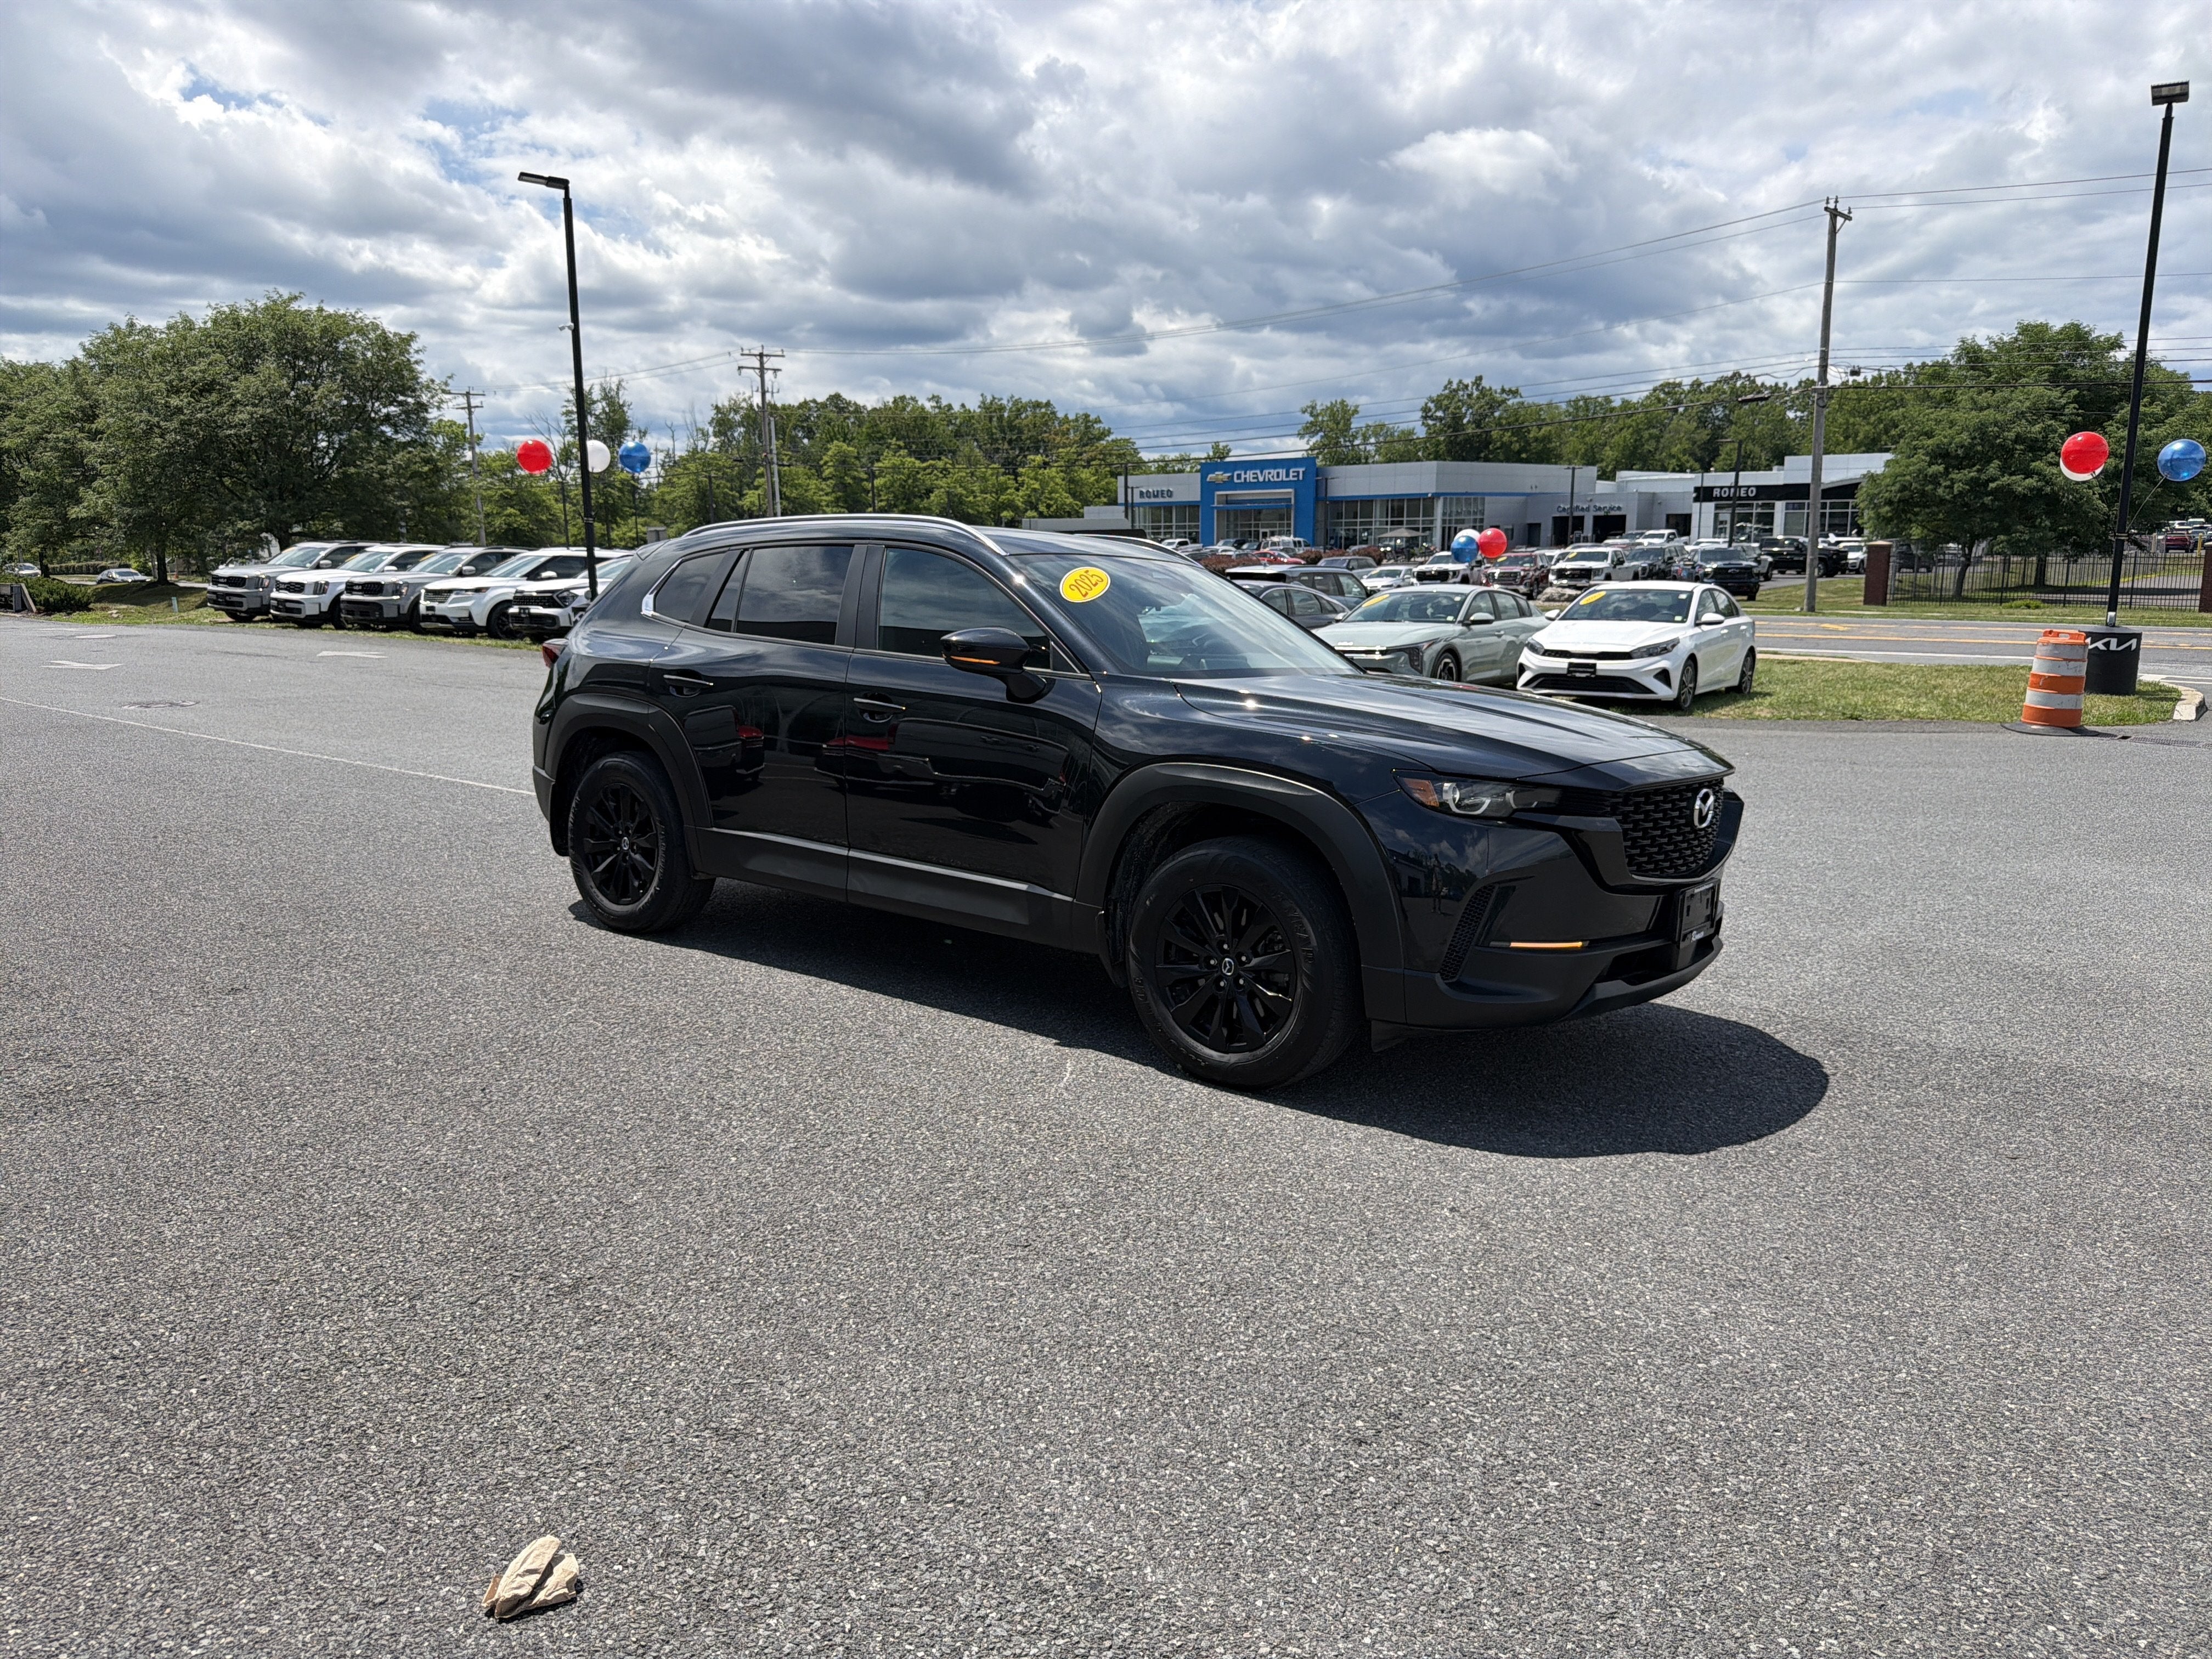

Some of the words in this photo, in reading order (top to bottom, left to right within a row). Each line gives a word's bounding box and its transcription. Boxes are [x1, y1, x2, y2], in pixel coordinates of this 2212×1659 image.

[1234, 468, 1305, 483] CHEVROLET
[1139, 488, 1173, 499] ROMEO
[1593, 504, 1622, 512] Service
[1069, 569, 1104, 597] 2025
[2085, 637, 2137, 651] KIA
